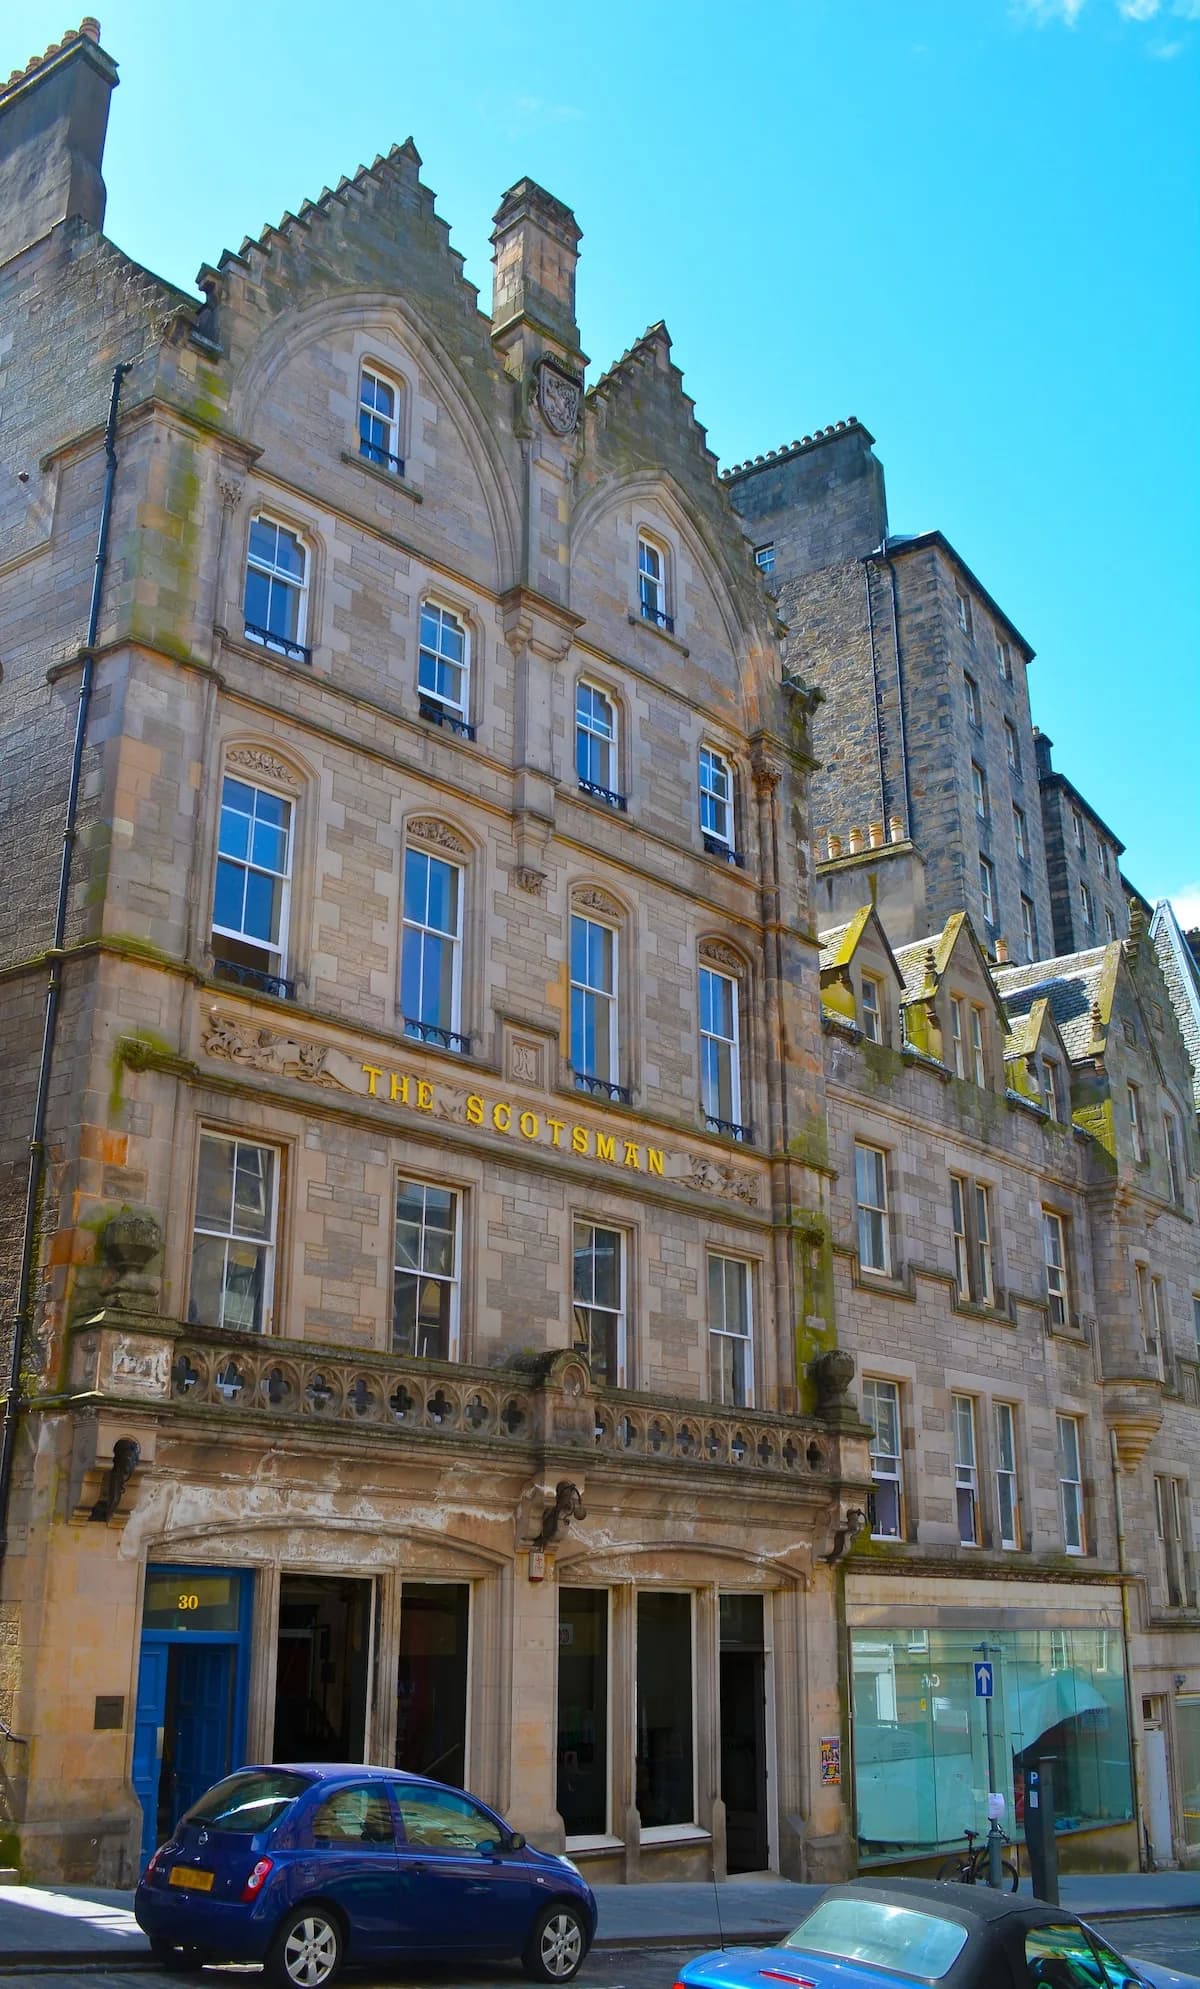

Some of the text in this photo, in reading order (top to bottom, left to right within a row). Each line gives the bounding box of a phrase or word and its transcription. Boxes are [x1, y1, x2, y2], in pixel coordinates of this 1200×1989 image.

[362, 1064, 665, 1176] THE SCOTSMAN
[178, 1594, 199, 1610] 30
[1030, 1771, 1038, 1785] P
